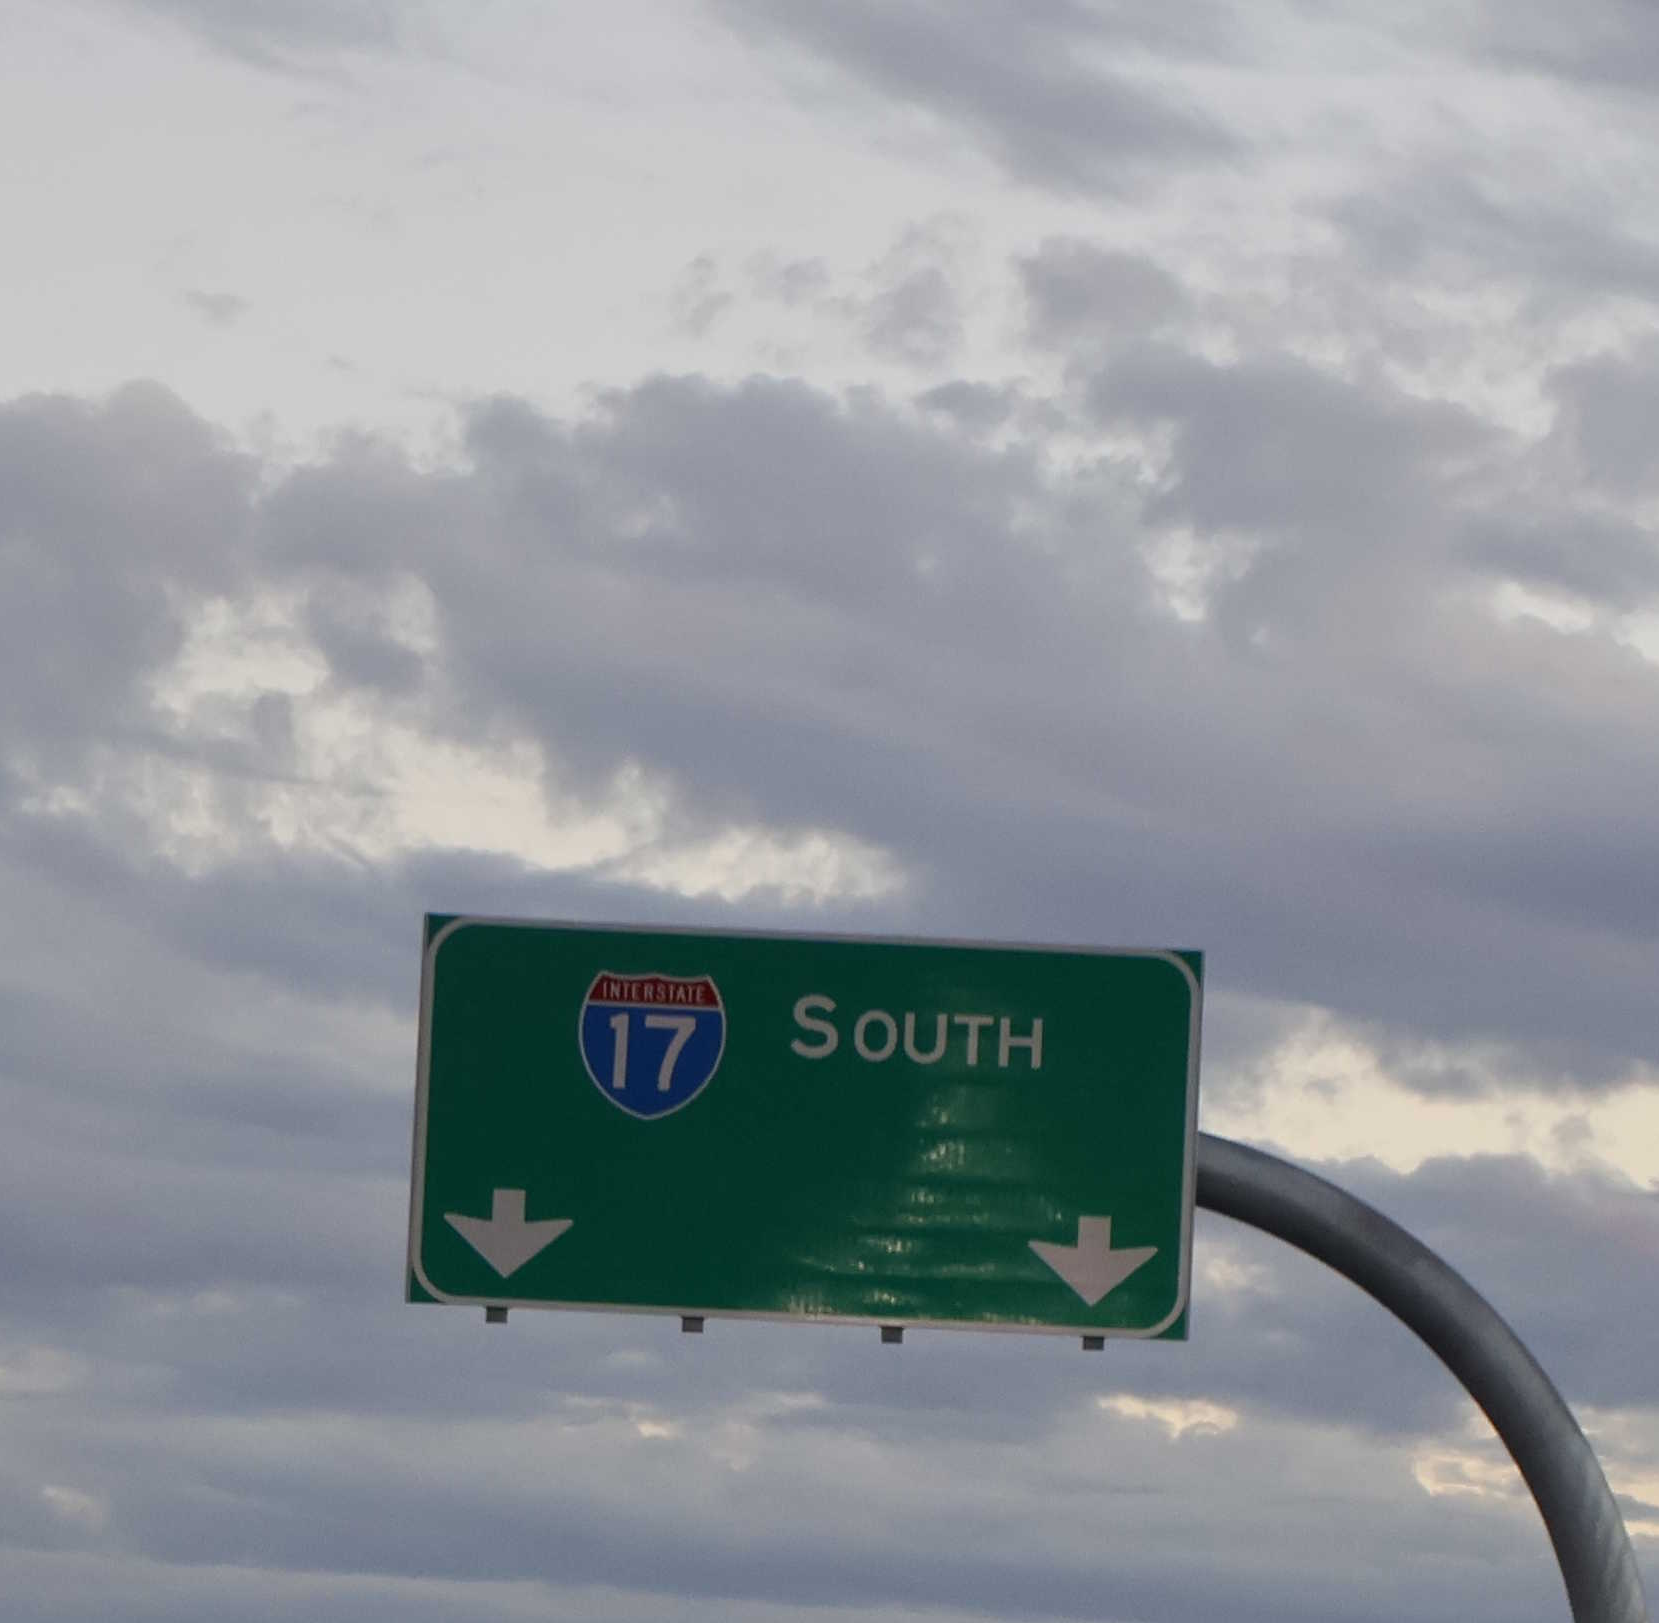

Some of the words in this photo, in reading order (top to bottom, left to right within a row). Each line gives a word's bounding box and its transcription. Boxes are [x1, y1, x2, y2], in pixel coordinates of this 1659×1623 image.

[602, 980, 705, 1003] INTERSTATE
[609, 1012, 697, 1092] 17
[790, 994, 1045, 1070] SOUTH
